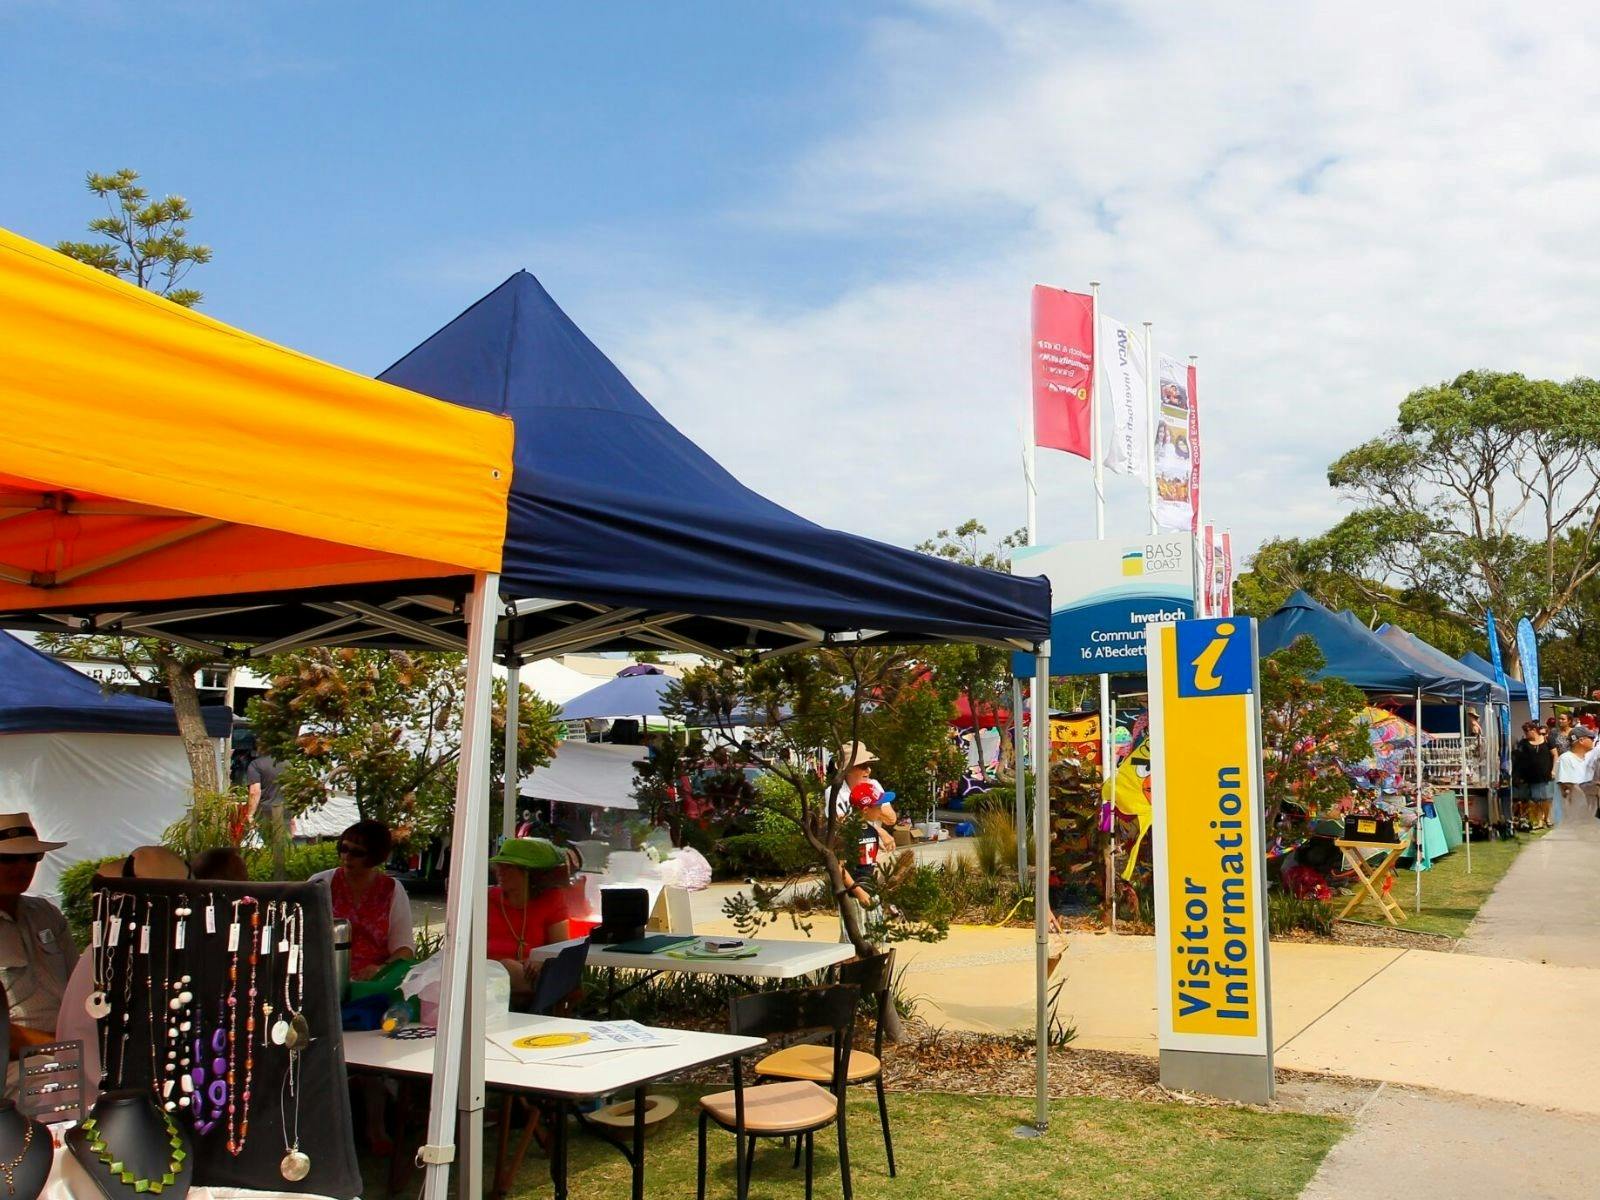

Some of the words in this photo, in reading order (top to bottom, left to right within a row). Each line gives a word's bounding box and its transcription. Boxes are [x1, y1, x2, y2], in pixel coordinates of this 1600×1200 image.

[1146, 543, 1182, 559] BASS
[1146, 558, 1181, 571] COAST
[1130, 608, 1186, 624] Inverloch
[1091, 628, 1147, 642] Communi
[1081, 647, 1092, 659] 16
[1210, 766, 1250, 1020] Information
[1177, 877, 1212, 1017] Visitor
